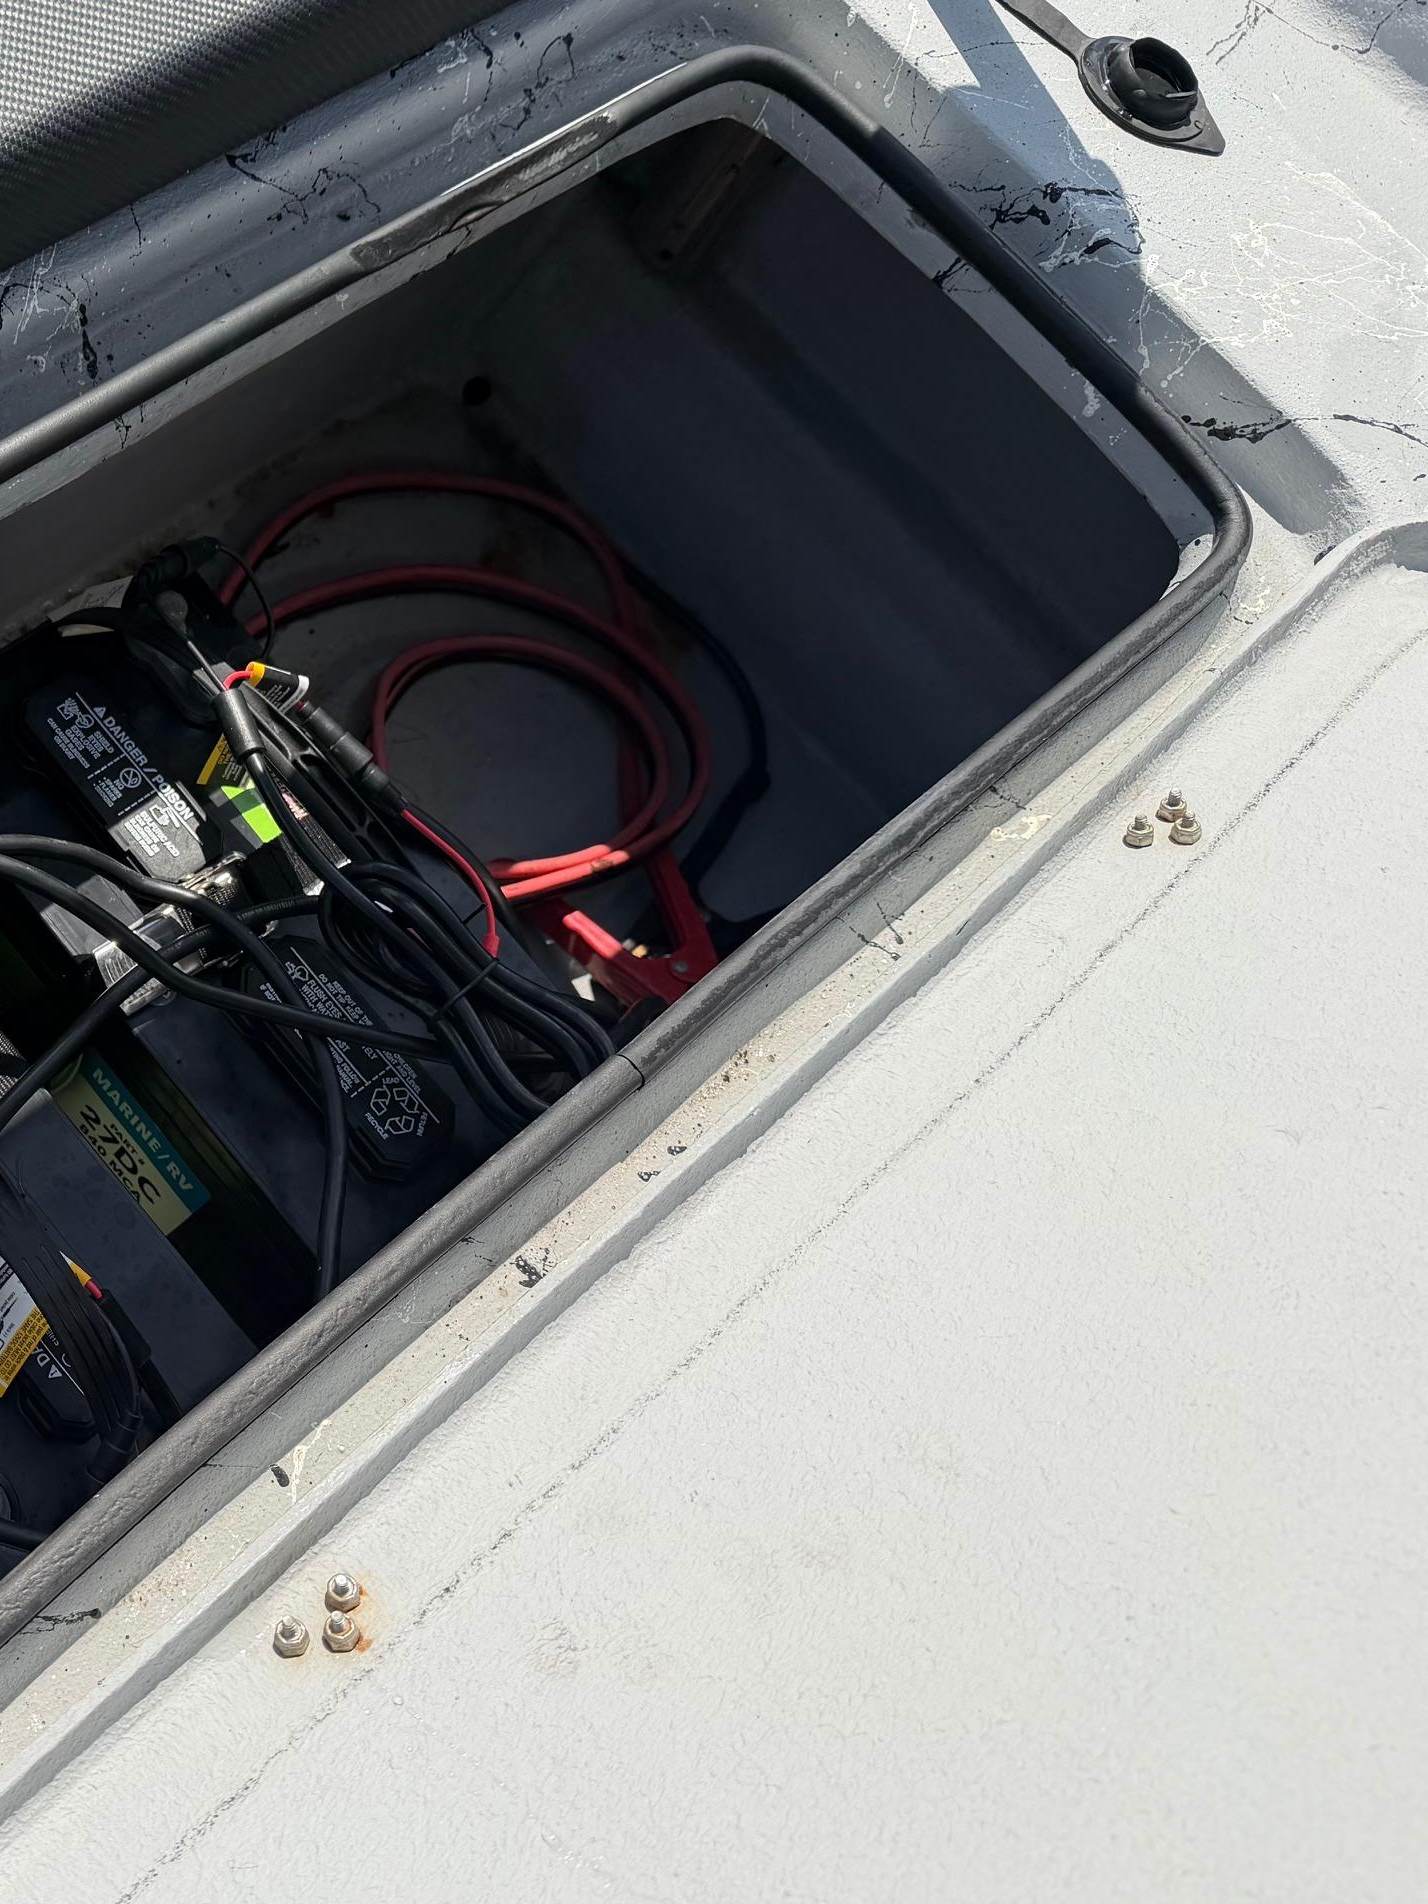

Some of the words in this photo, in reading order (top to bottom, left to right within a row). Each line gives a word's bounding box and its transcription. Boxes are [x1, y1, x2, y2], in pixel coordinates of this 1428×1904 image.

[64, 728, 84, 751] GASES
[69, 724, 101, 759] EXPLOSIVE
[87, 734, 104, 752] EYES
[93, 730, 115, 754] SHIELD
[102, 715, 148, 767] DANGER
[151, 772, 194, 821] POISON
[112, 778, 125, 791] NO
[163, 839, 180, 858] ACID
[300, 983, 317, 1003] WITH
[306, 978, 327, 1002] FLUSH
[325, 981, 337, 995] NOT
[343, 993, 356, 1008] OUT
[340, 1061, 360, 1085] FOLLOW
[365, 1112, 389, 1141] RECYCLE
[78, 1103, 163, 1205] 27DC
[107, 1159, 144, 1202] MCA
